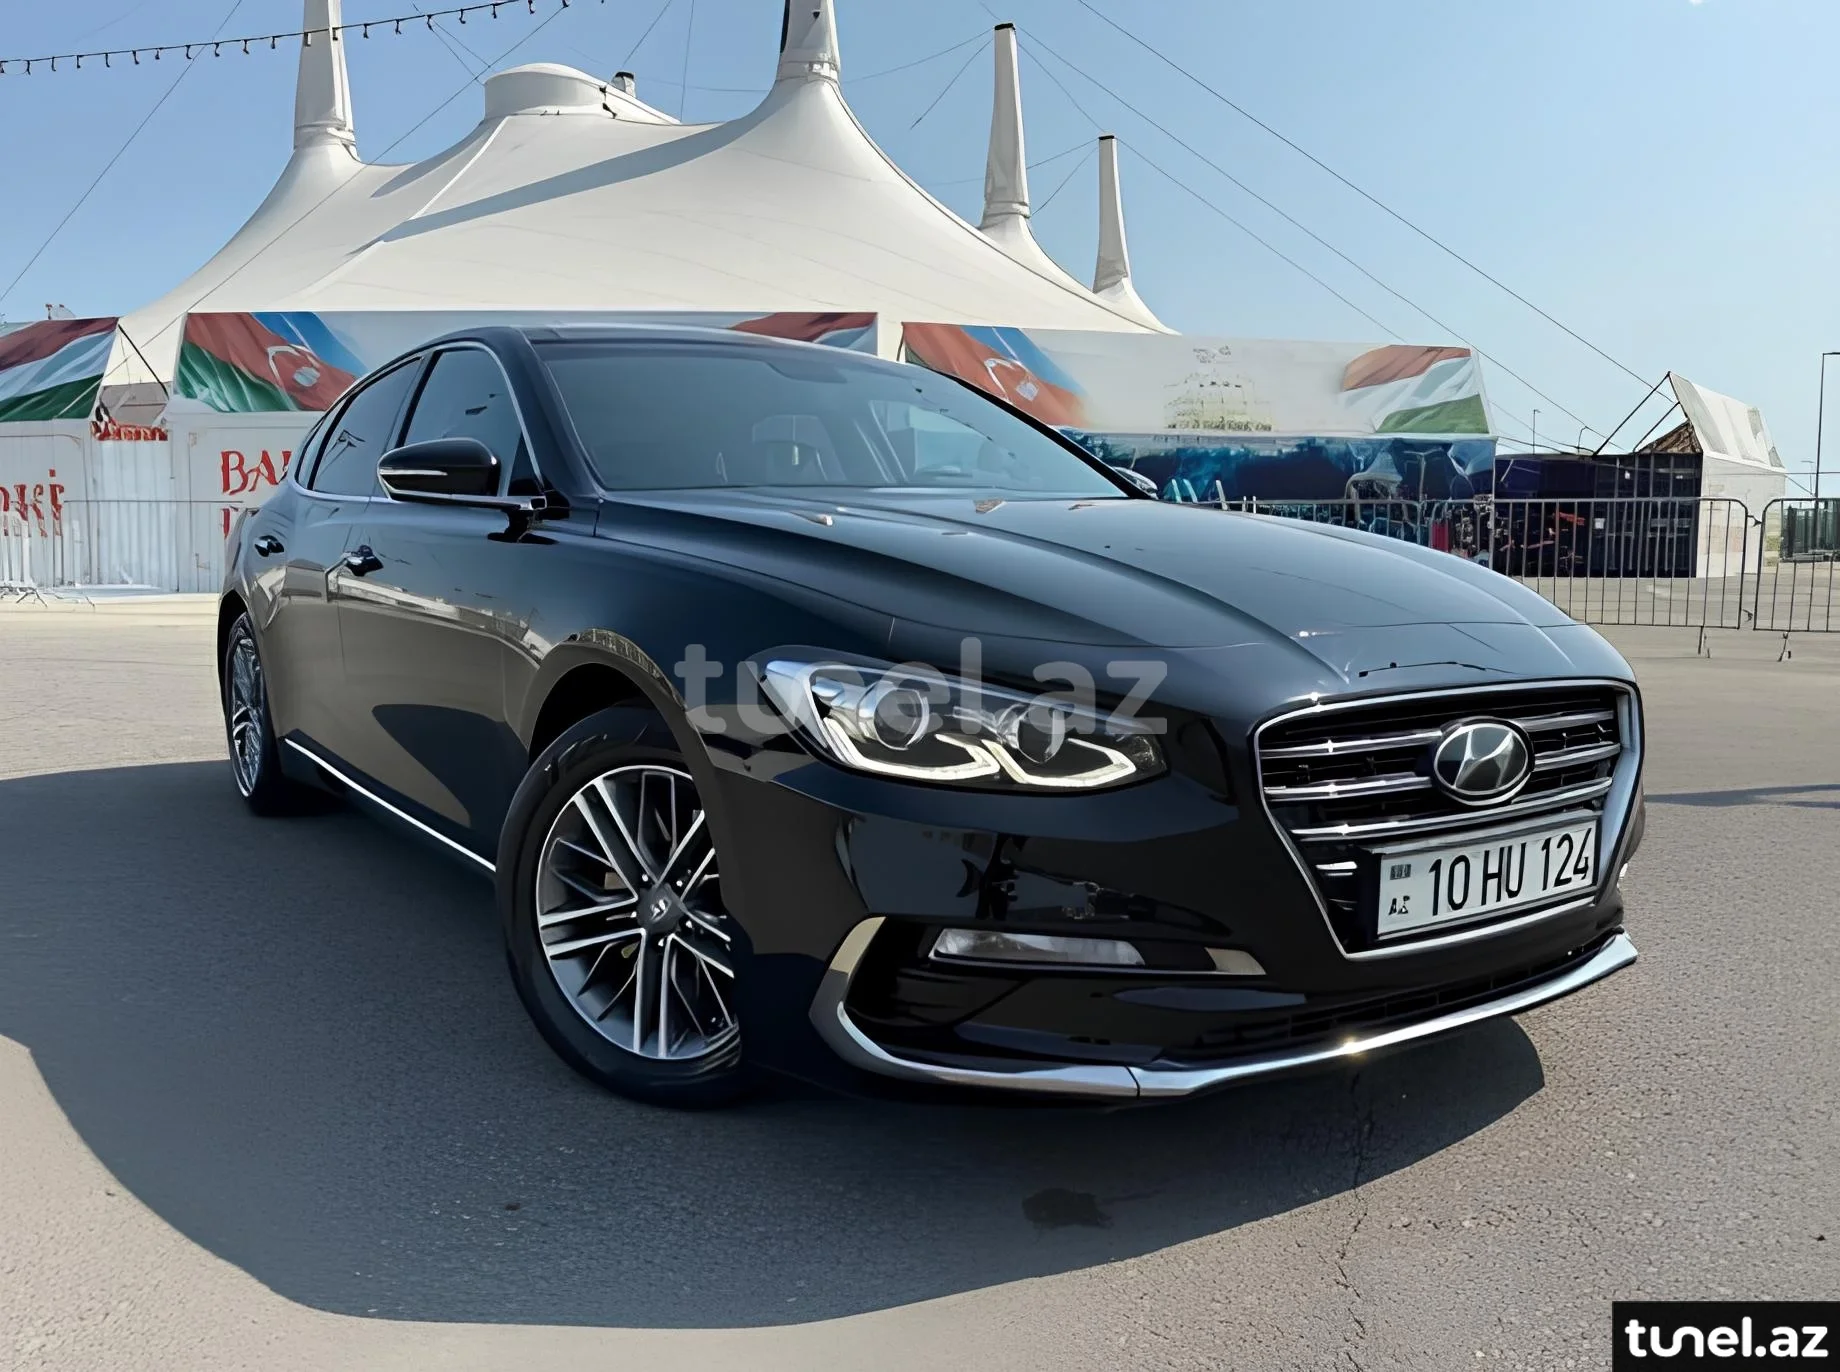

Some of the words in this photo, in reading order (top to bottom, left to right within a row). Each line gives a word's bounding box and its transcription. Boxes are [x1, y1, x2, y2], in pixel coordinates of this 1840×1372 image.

[1428, 854, 1470, 916] 10
[1481, 842, 1527, 906] HU
[1541, 827, 1592, 891] 124
